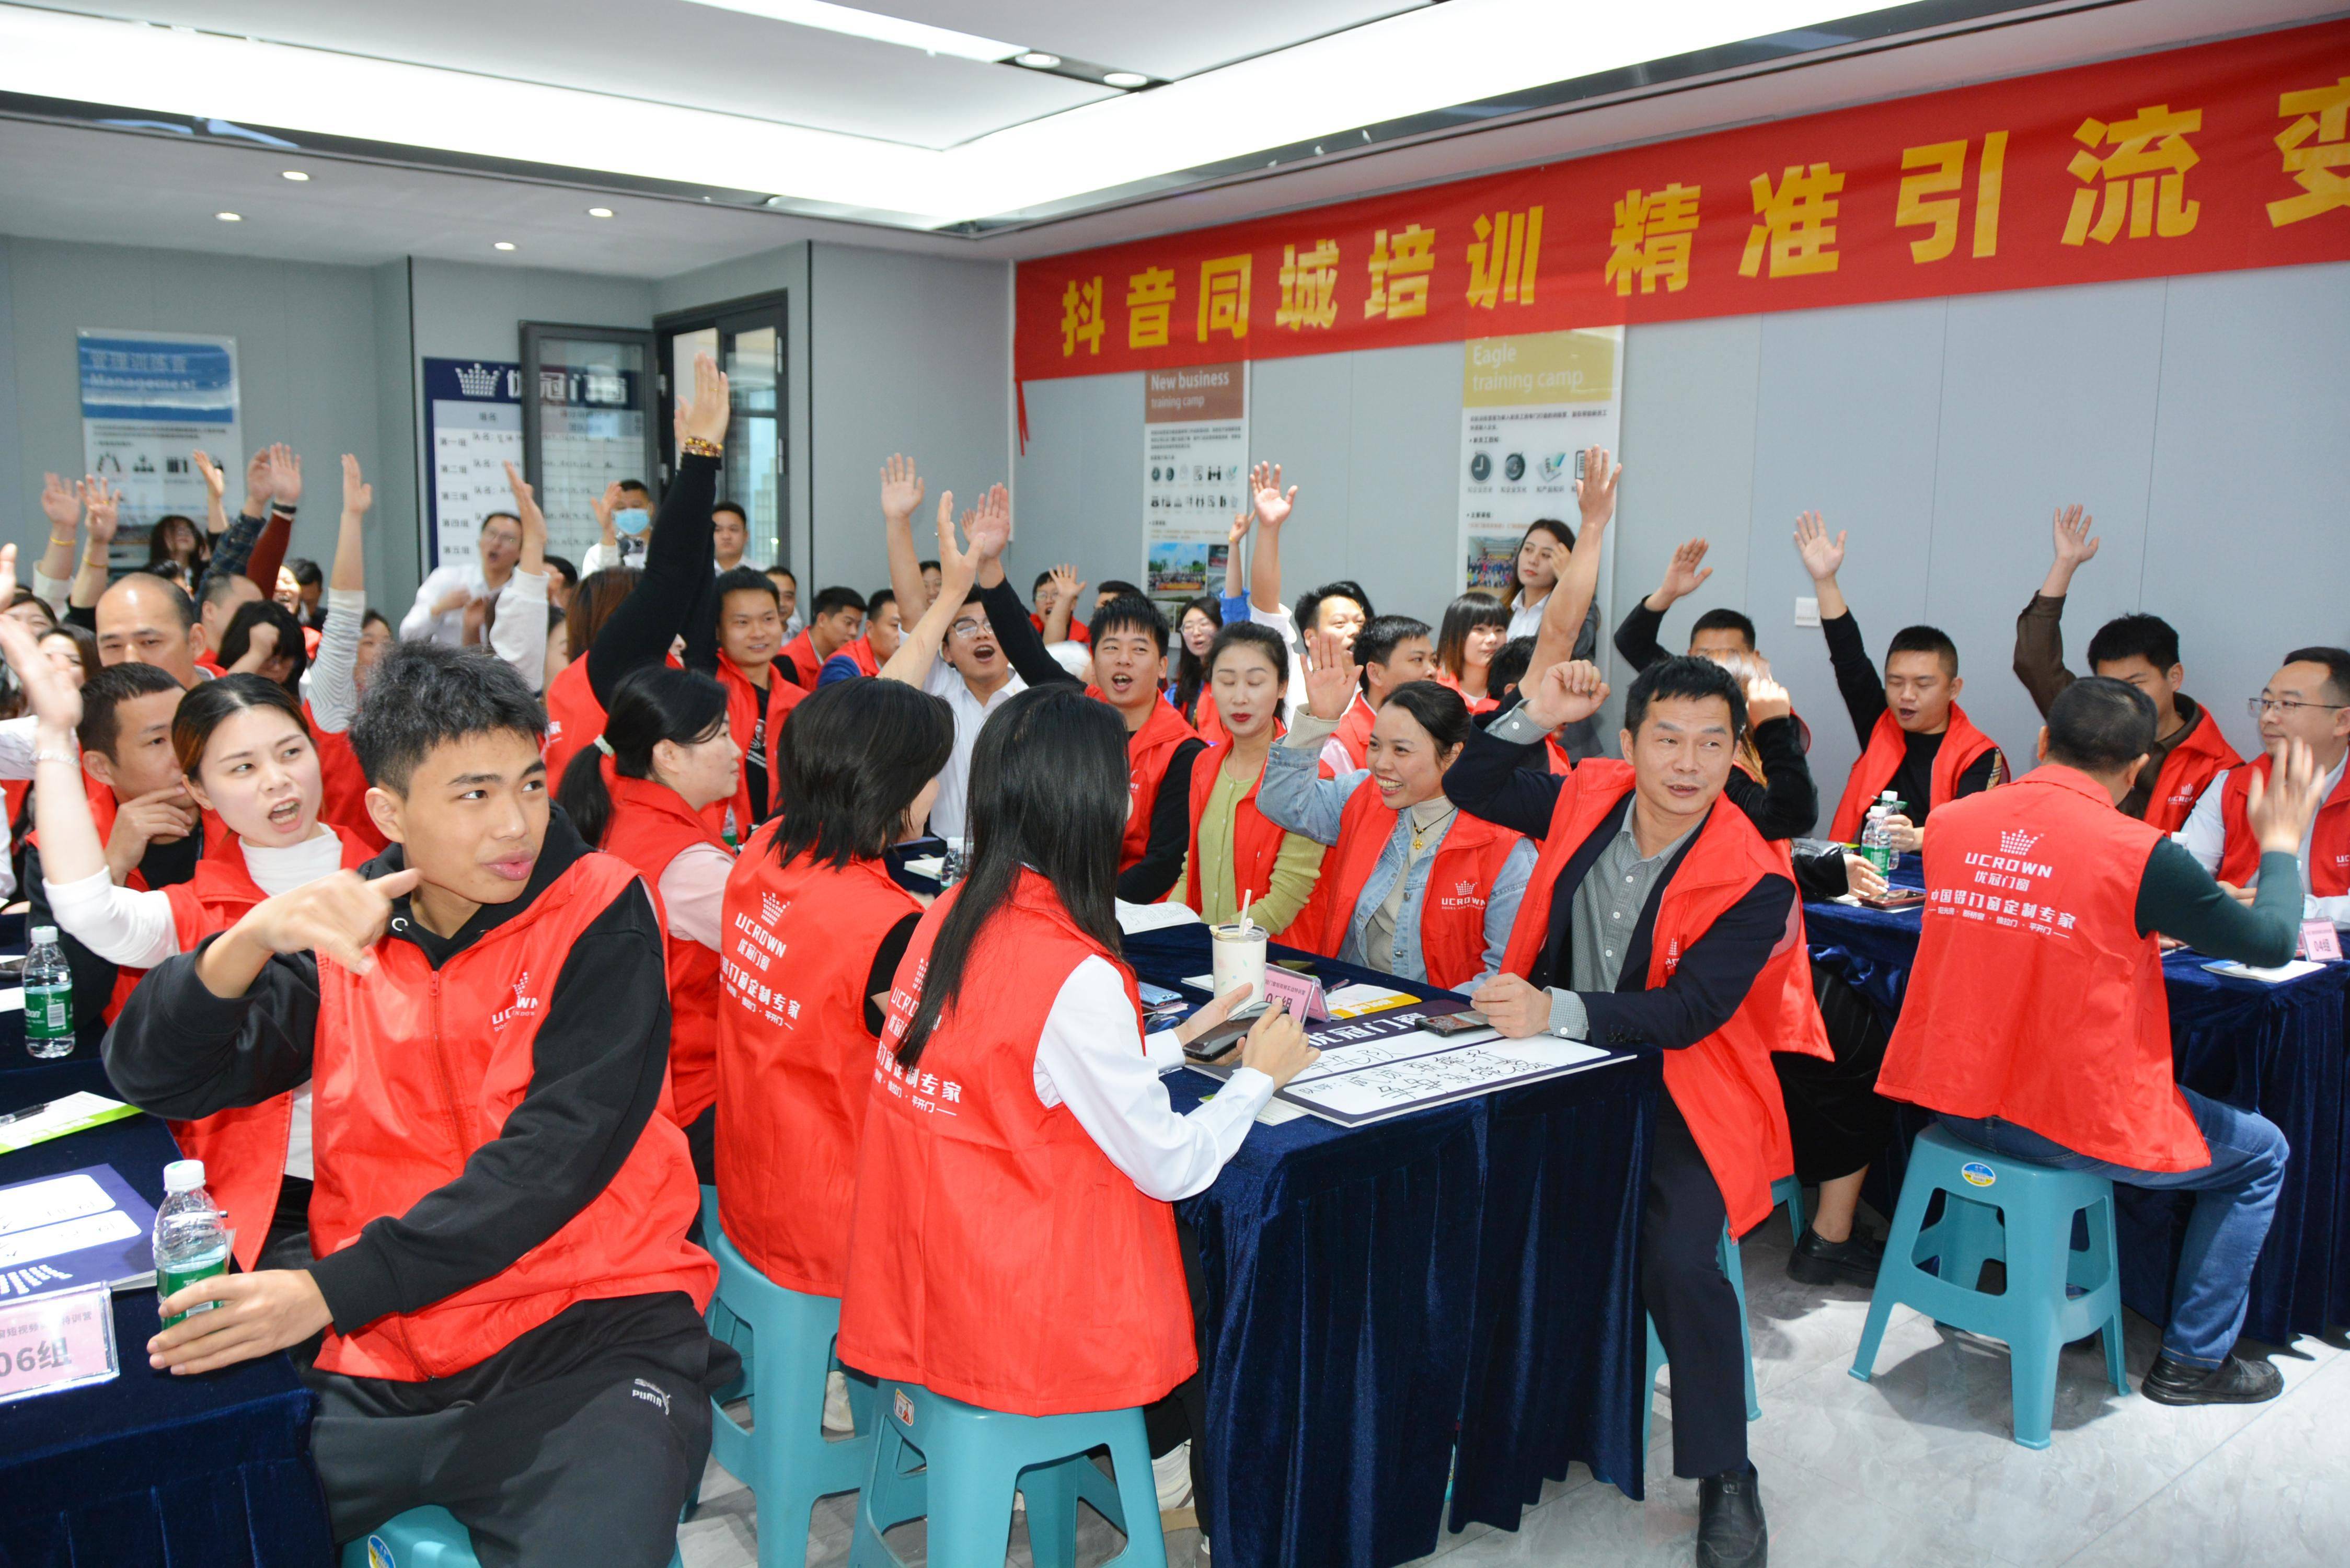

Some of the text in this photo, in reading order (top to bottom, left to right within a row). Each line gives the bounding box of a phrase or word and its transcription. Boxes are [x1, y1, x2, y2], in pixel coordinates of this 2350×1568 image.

[1061, 205, 1543, 356] 抖音同城培训
[1473, 342, 1516, 367] Eagle
[1151, 370, 1229, 391] New business
[1472, 369, 1583, 393] training camp
[1151, 395, 1204, 409] training camp
[1965, 852, 2053, 879] UCROWN
[1974, 870, 2030, 892] 优冠门窗
[1931, 889, 2076, 930] 中国铝门窗定制专家
[734, 912, 787, 959] UCROWN
[736, 938, 771, 972] 优冠门窗
[0, 1311, 92, 1339] 短视频特训营
[632, 1389, 662, 1408] PUMA
